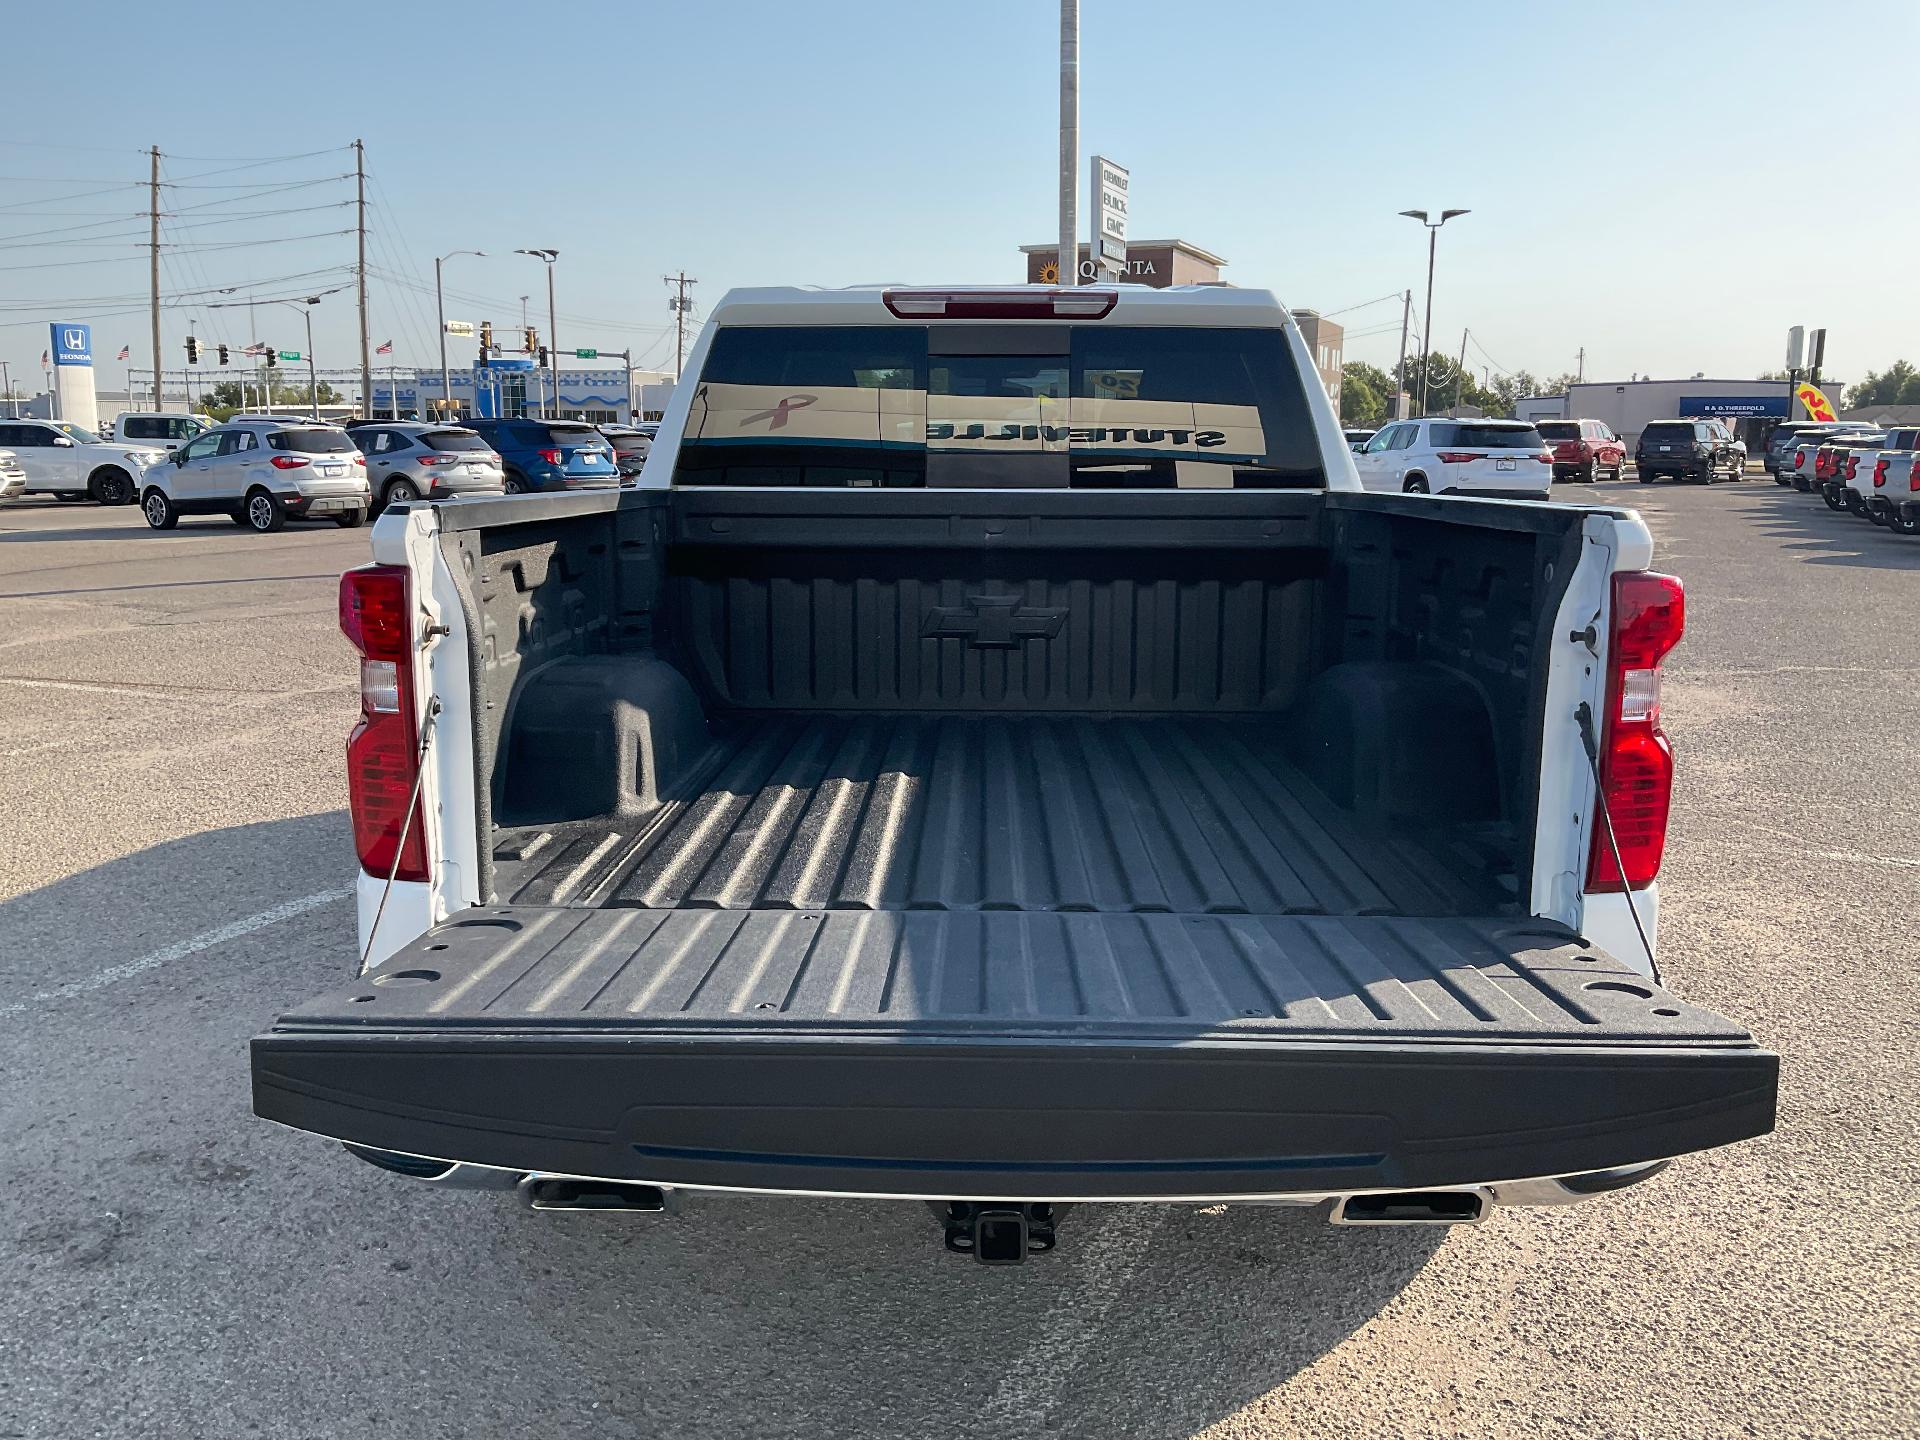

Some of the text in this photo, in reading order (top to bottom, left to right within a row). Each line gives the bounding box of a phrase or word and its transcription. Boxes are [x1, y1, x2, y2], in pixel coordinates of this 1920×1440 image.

[1103, 192, 1127, 214] BUICK
[1106, 217, 1124, 236] GMC
[1080, 260, 1157, 281] QNTA
[59, 353, 92, 361] HONDA
